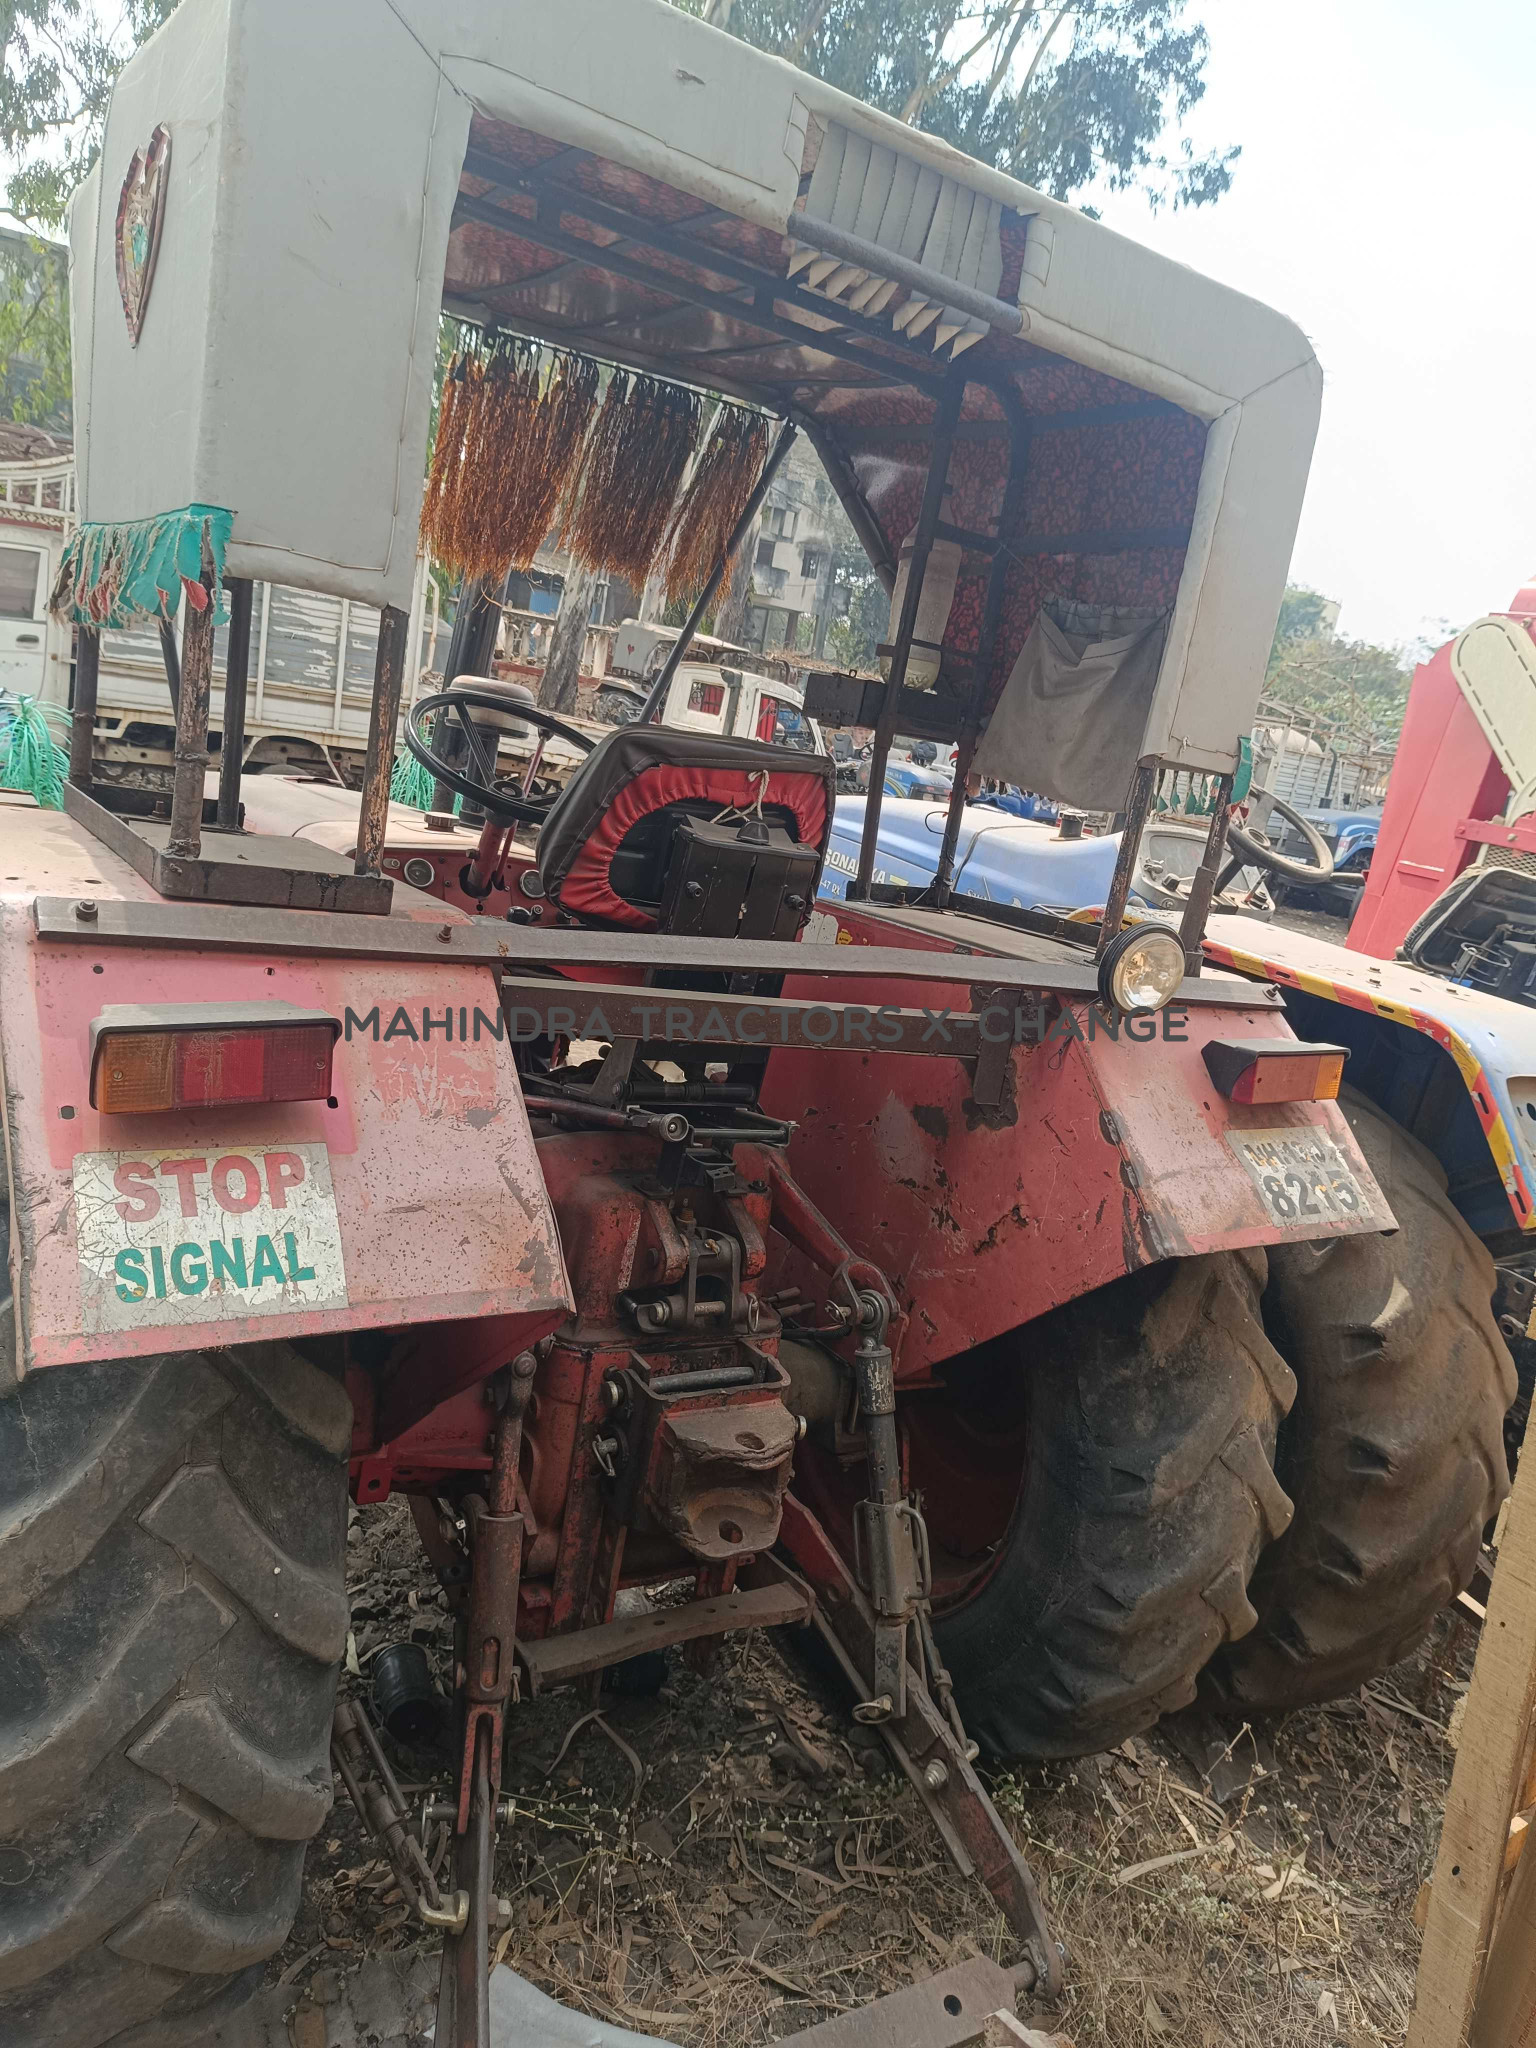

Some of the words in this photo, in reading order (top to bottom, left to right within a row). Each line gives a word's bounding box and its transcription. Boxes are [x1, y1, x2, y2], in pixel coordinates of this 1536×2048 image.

[113, 1151, 306, 1223] STOP
[1262, 1170, 1360, 1218] 8215
[114, 1231, 317, 1304] SIGNAL
